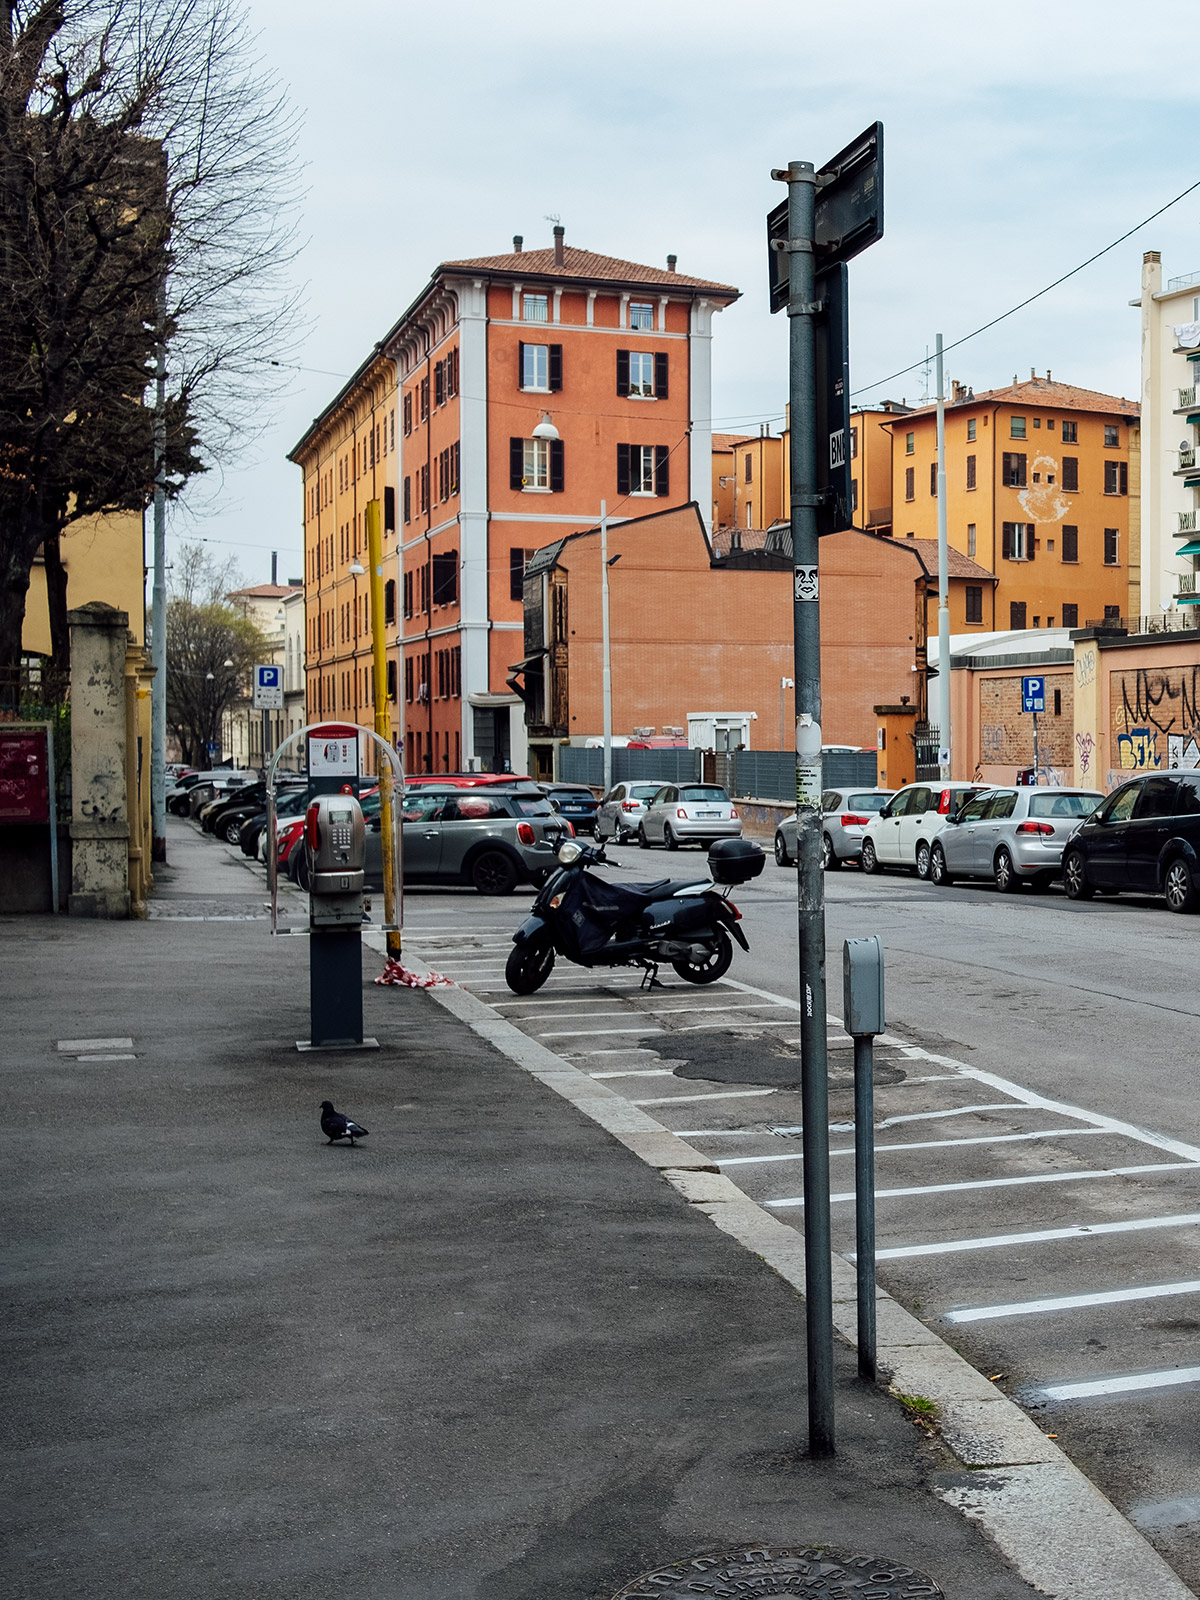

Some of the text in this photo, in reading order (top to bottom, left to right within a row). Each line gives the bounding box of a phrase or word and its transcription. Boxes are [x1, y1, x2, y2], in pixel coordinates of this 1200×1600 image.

[264, 670, 275, 684] P
[1028, 679, 1041, 697] P
[1028, 775, 1036, 785] P
